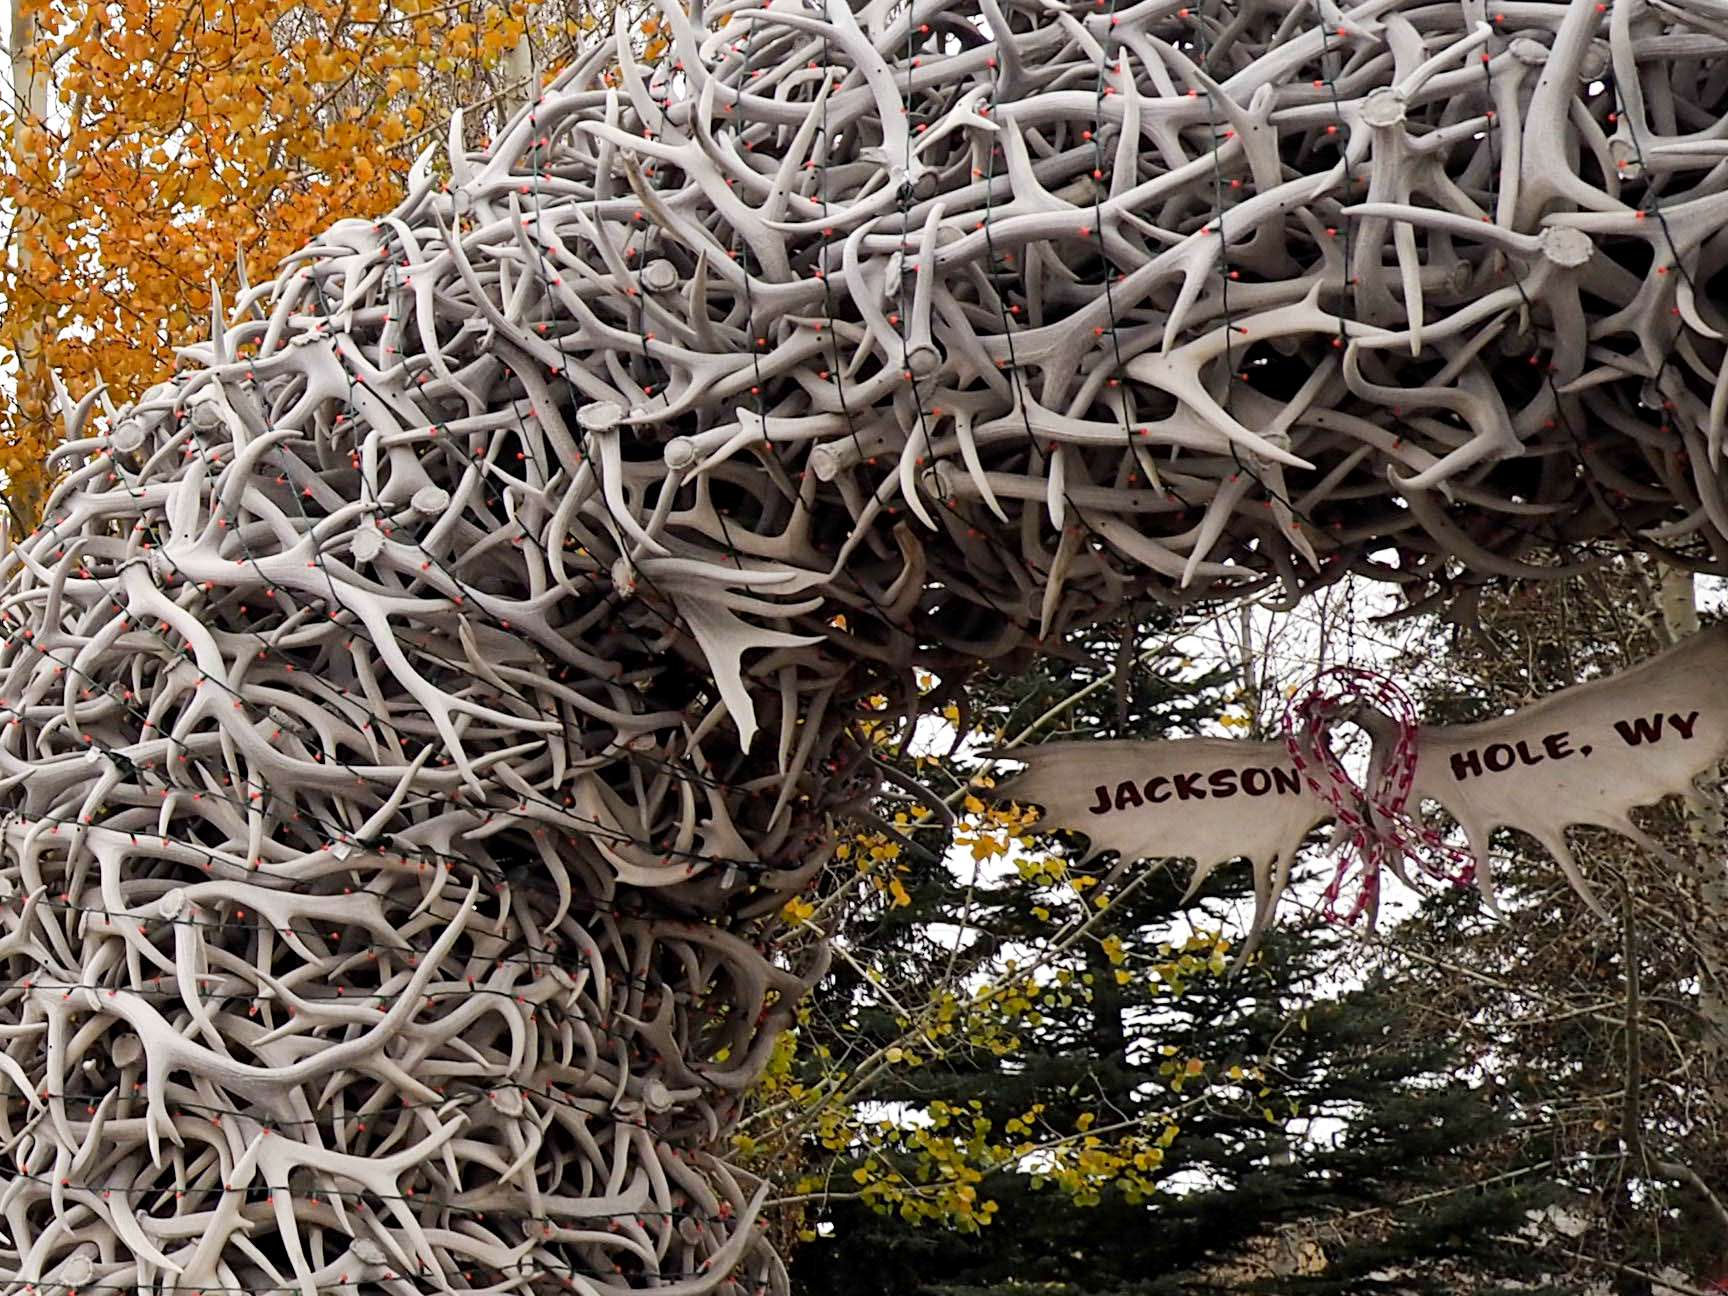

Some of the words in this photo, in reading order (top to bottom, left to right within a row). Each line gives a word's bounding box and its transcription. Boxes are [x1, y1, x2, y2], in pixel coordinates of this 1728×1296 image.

[1087, 765, 1303, 816] JACKSON
[1449, 730, 1594, 781] HOLE,
[1613, 710, 1702, 747] WY
